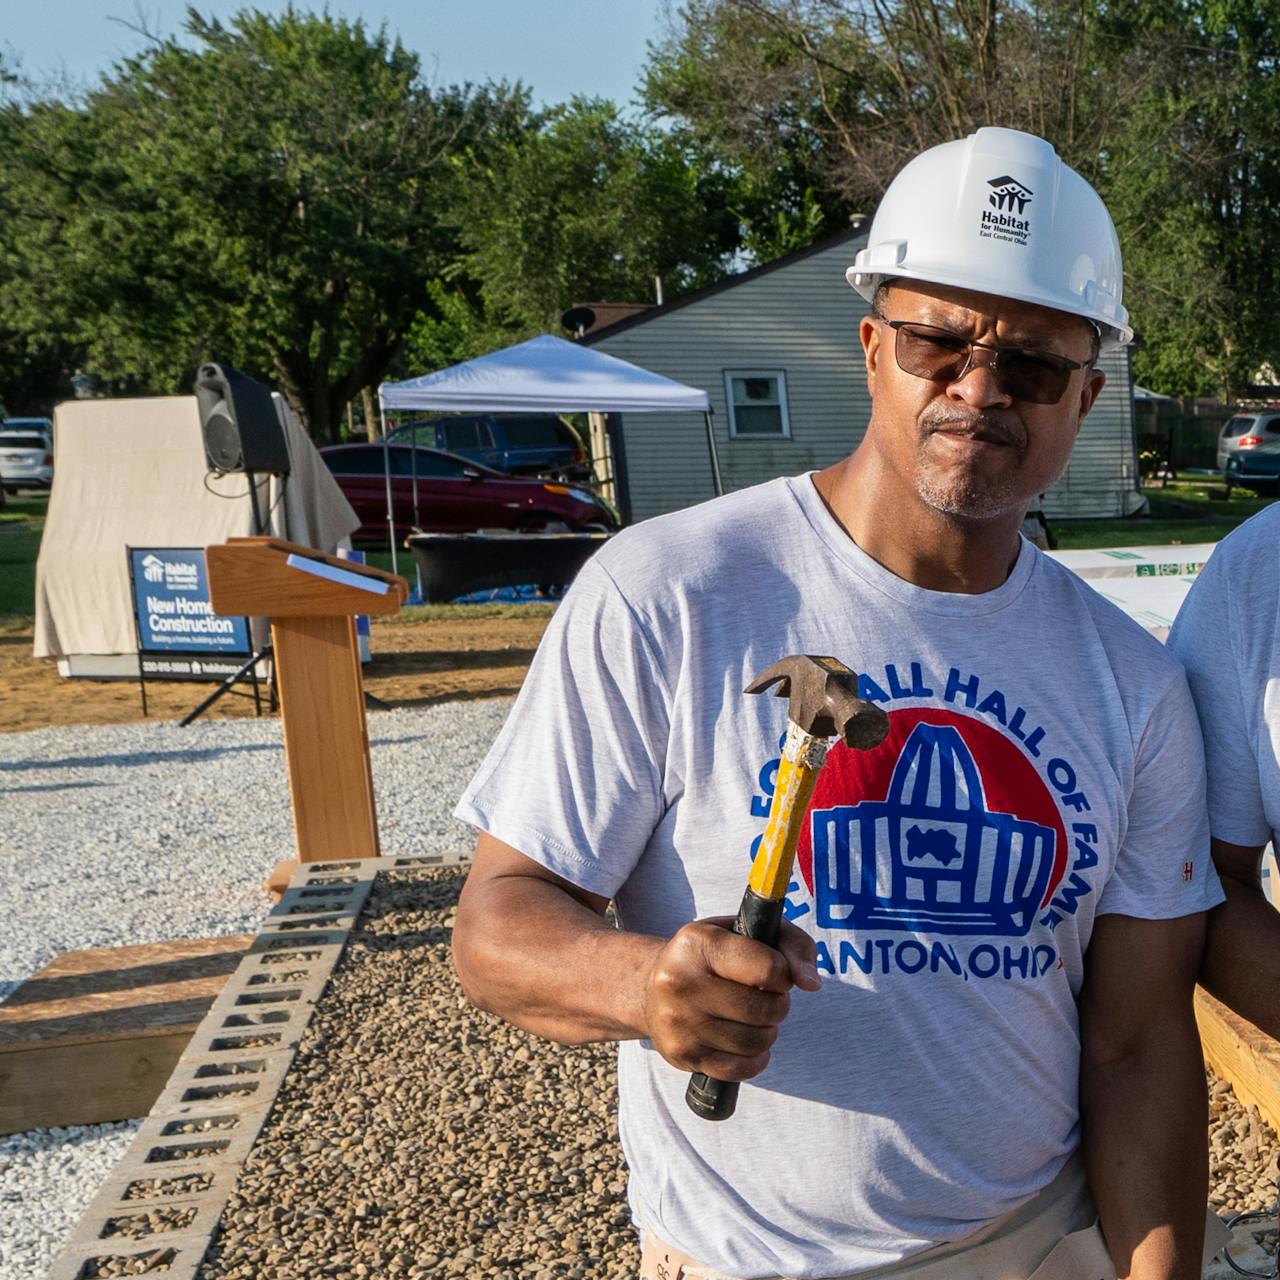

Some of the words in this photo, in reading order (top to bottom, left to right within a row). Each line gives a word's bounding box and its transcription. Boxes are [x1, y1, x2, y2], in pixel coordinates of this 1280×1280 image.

[982, 210, 1030, 231] Habitat
[980, 230, 992, 239] East
[993, 233, 1013, 242] Central
[1014, 238, 1028, 246] Ohio
[981, 223, 992, 231] for
[993, 225, 1028, 239] Humanity
[146, 596, 175, 614] New
[149, 614, 234, 633] Construction
[944, 667, 1047, 758] HALL
[1046, 757, 1091, 813] OF
[816, 938, 968, 981] ANTON,
